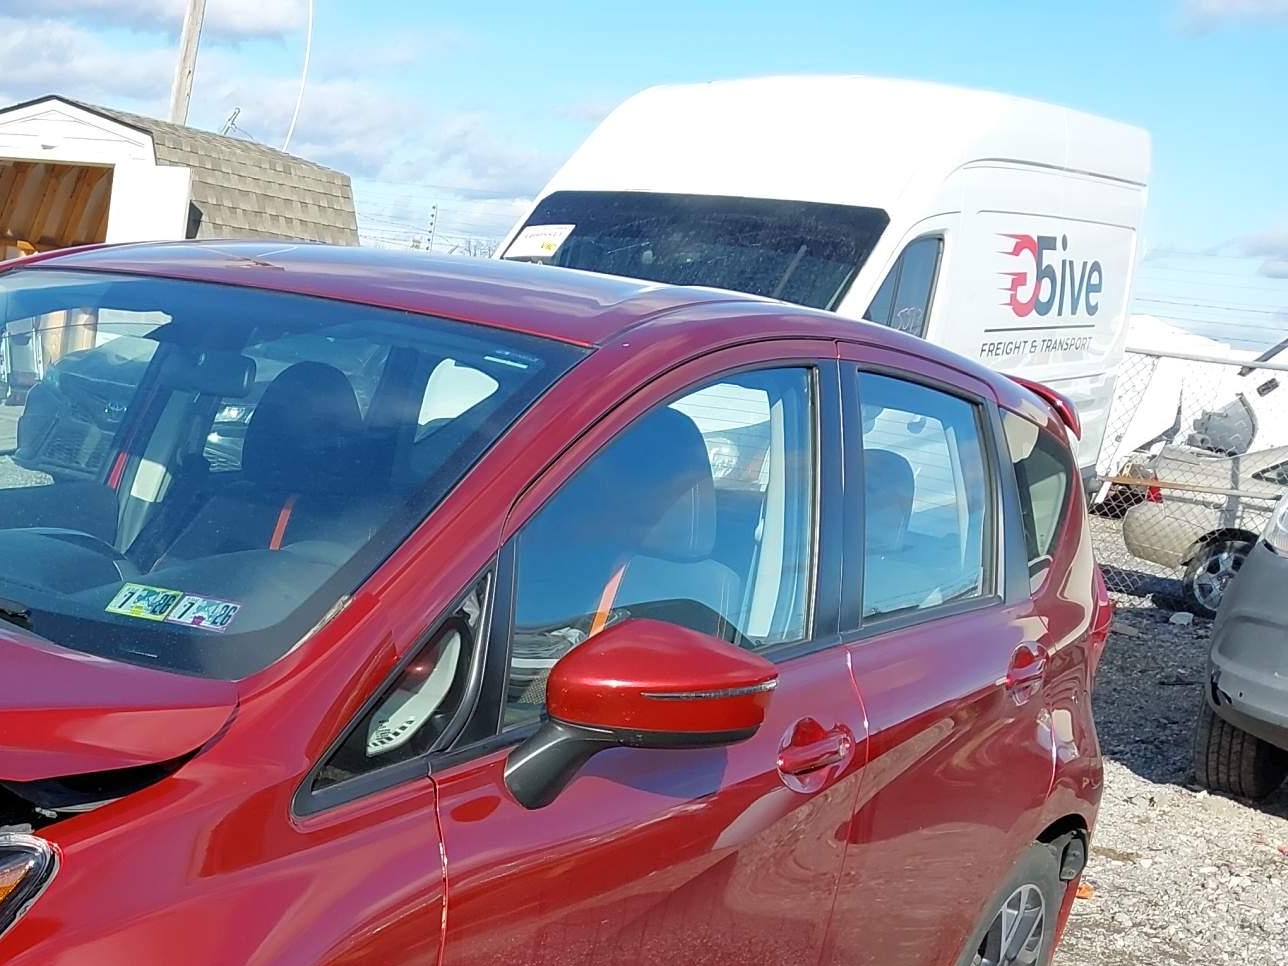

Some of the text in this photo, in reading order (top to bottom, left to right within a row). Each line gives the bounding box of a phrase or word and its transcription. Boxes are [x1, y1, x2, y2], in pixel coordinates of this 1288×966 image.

[980, 336, 1094, 358] FREIGHT & TRANSPORT
[211, 604, 238, 626] 26
